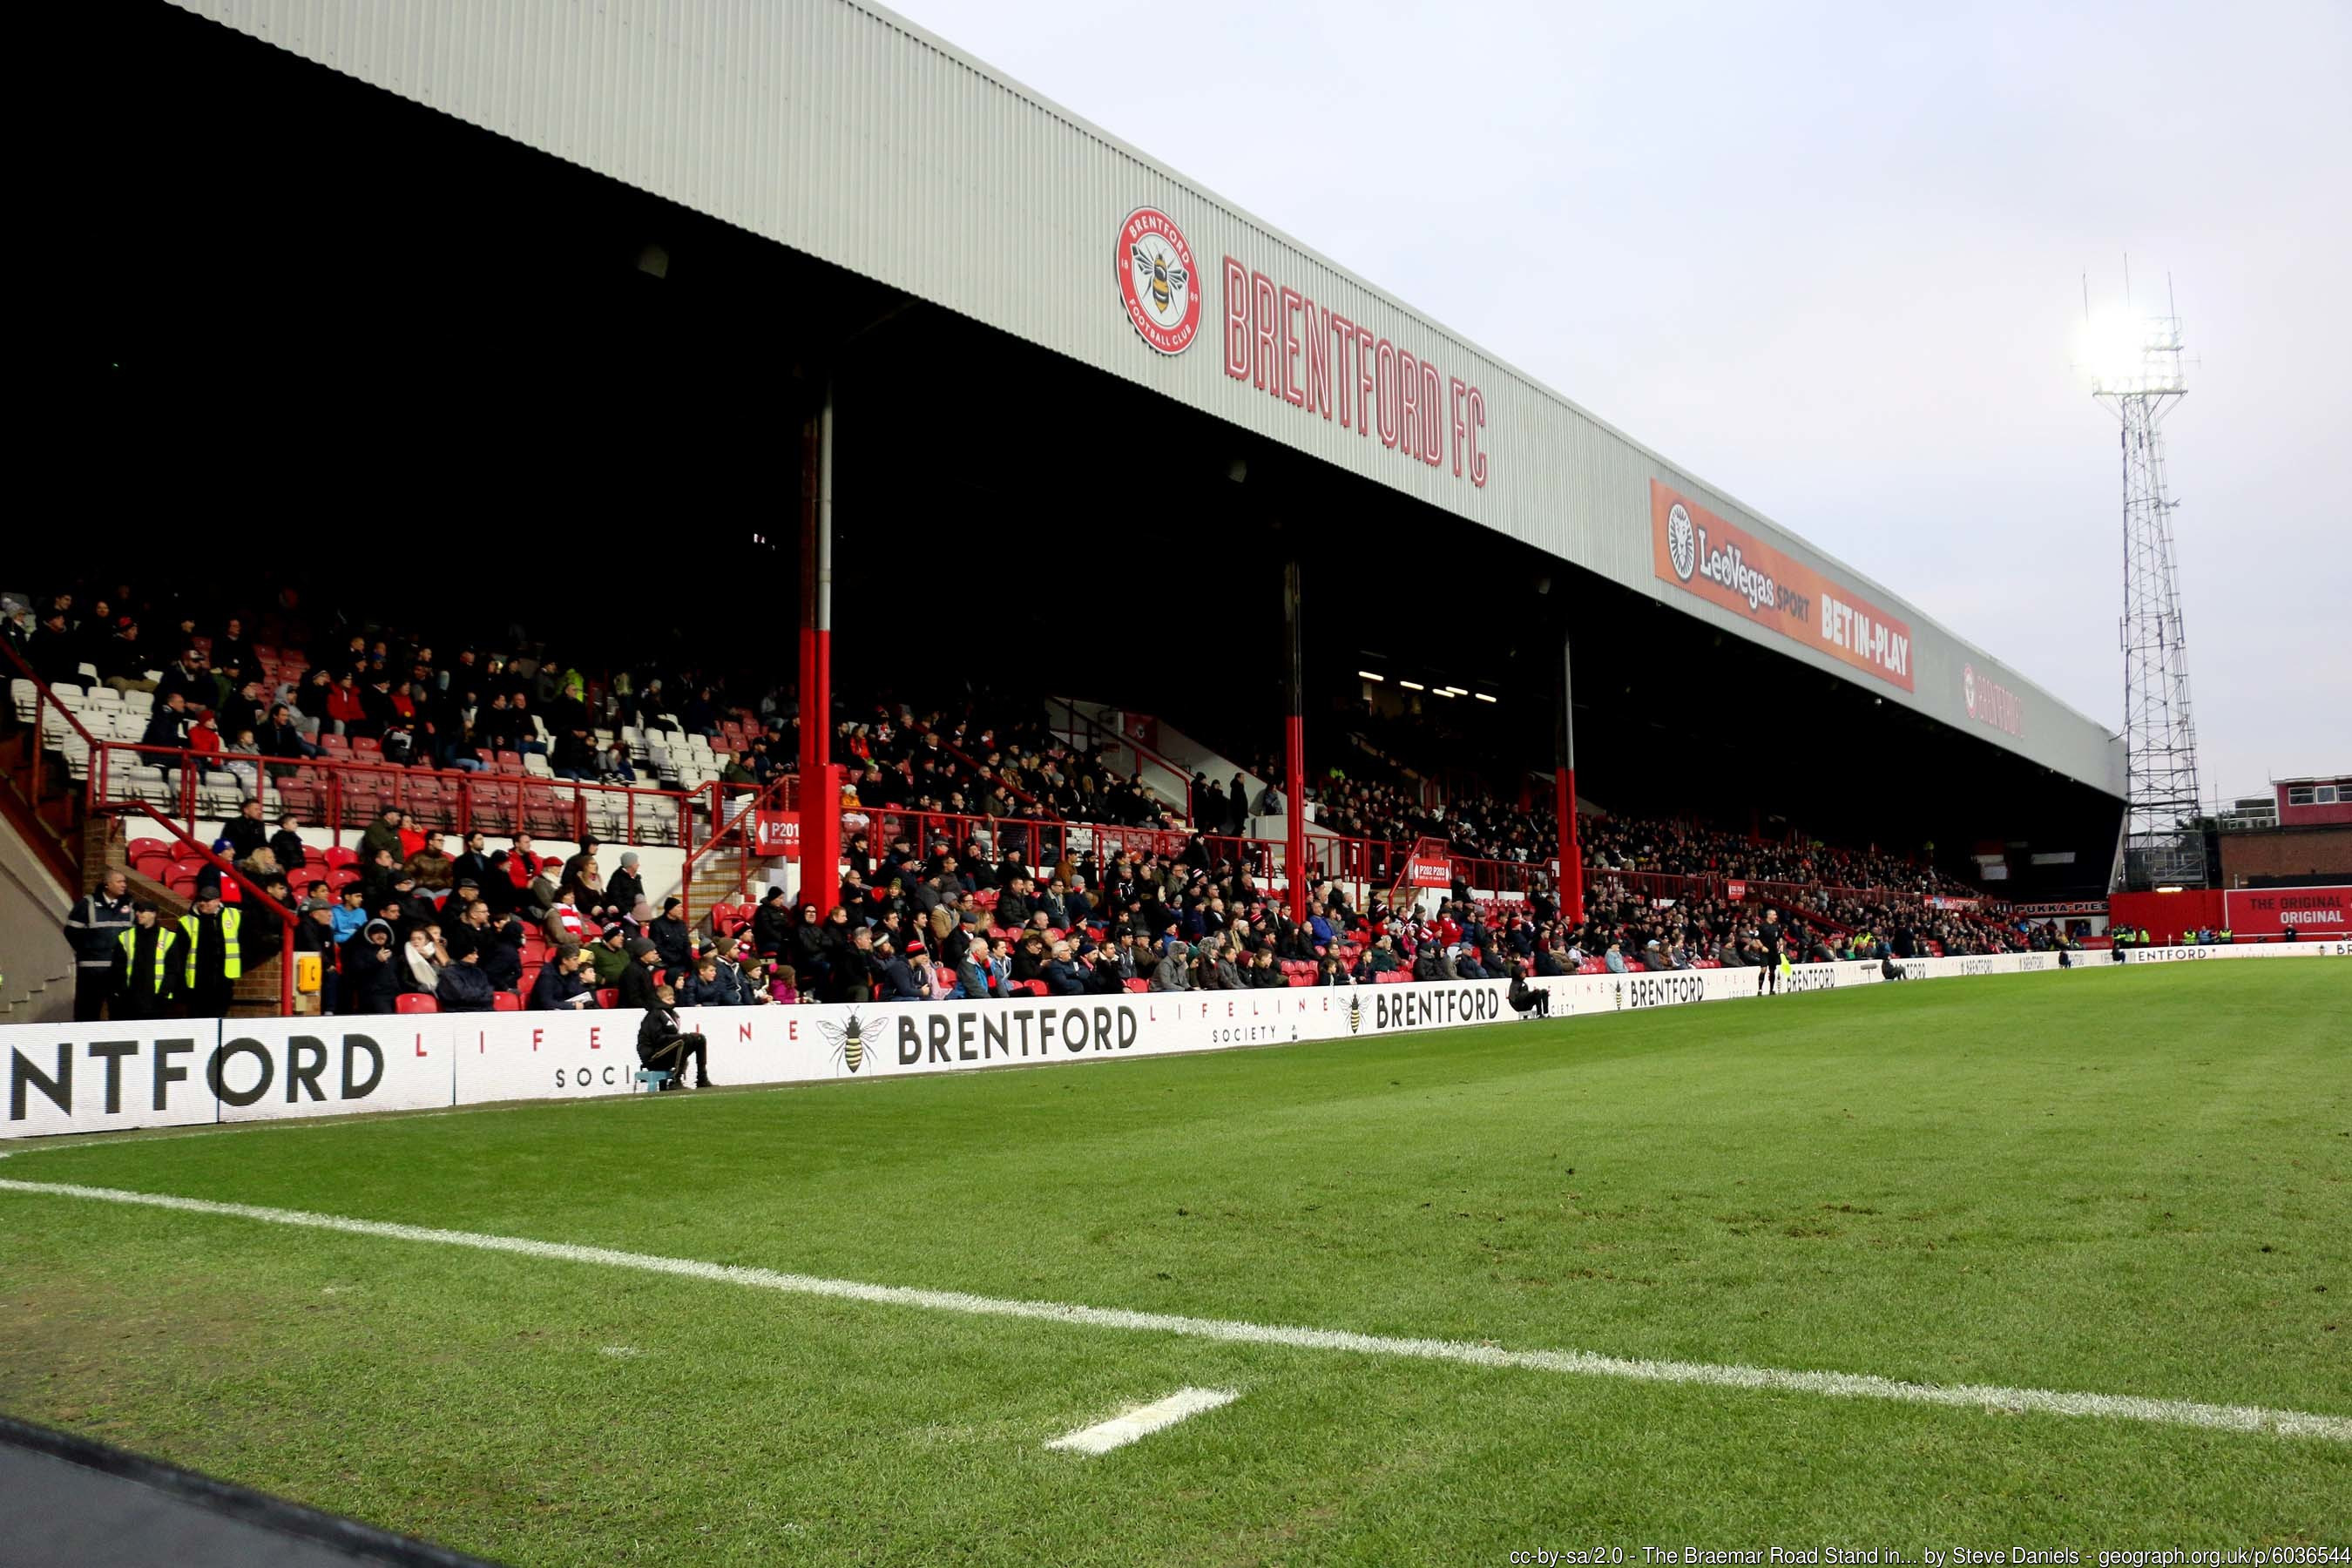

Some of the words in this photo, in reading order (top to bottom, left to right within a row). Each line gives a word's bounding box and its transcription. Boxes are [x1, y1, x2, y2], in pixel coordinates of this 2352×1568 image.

[1129, 215, 1190, 264] BRENTFORD
[1121, 258, 1129, 269] 18
[1190, 292, 1199, 303] 89
[1129, 299, 1171, 346] FOOTBALL
[1172, 323, 1193, 346] CLUB
[1223, 254, 1443, 468] BRENTFORD
[1450, 376, 1487, 488] FC
[1698, 528, 1775, 611] LeoVegas
[1777, 584, 1810, 623] SPORT
[1821, 592, 1853, 649] BET
[1854, 610, 1908, 676] IN-PLAY
[772, 821, 800, 837] P201
[2250, 898, 2274, 909] THE
[2281, 896, 2343, 908] ORIGINAL
[2281, 910, 2344, 923] ORIGINAL
[2139, 949, 2207, 962] ENTFORD
[1150, 997, 1328, 1022] LIFELINE
[1376, 987, 1499, 1030] BRENTFORD
[1631, 976, 1704, 1008] BRENTFORD
[898, 1004, 1137, 1065] BRENTFORD
[1213, 1025, 1276, 1043] SOCIETY
[556, 1064, 630, 1088] SOCI
